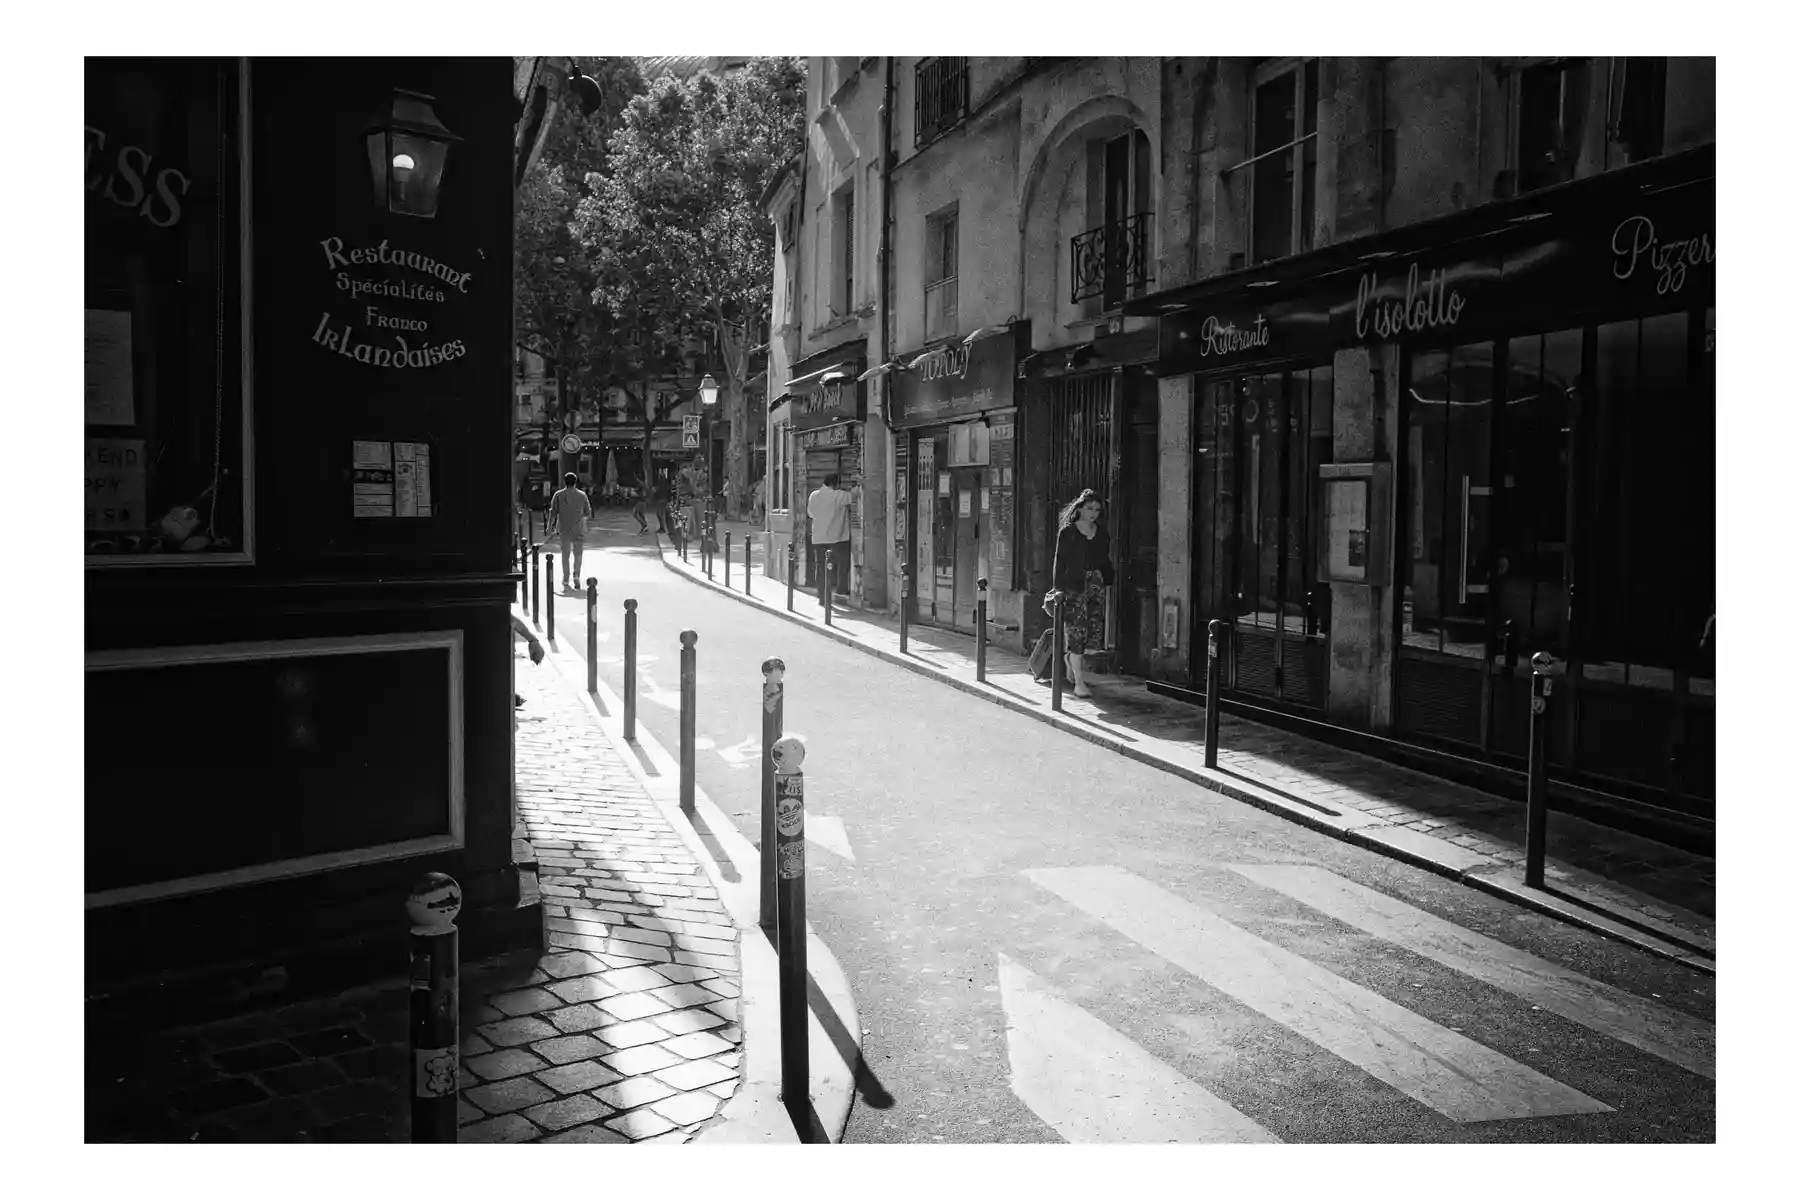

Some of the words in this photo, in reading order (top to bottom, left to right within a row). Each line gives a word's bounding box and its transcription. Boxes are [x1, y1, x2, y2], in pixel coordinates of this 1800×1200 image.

[319, 236, 472, 294] Restaurant
[366, 305, 429, 332] Franco
[1355, 262, 1466, 339] l'isolotto
[1200, 313, 1270, 356] Ristorante
